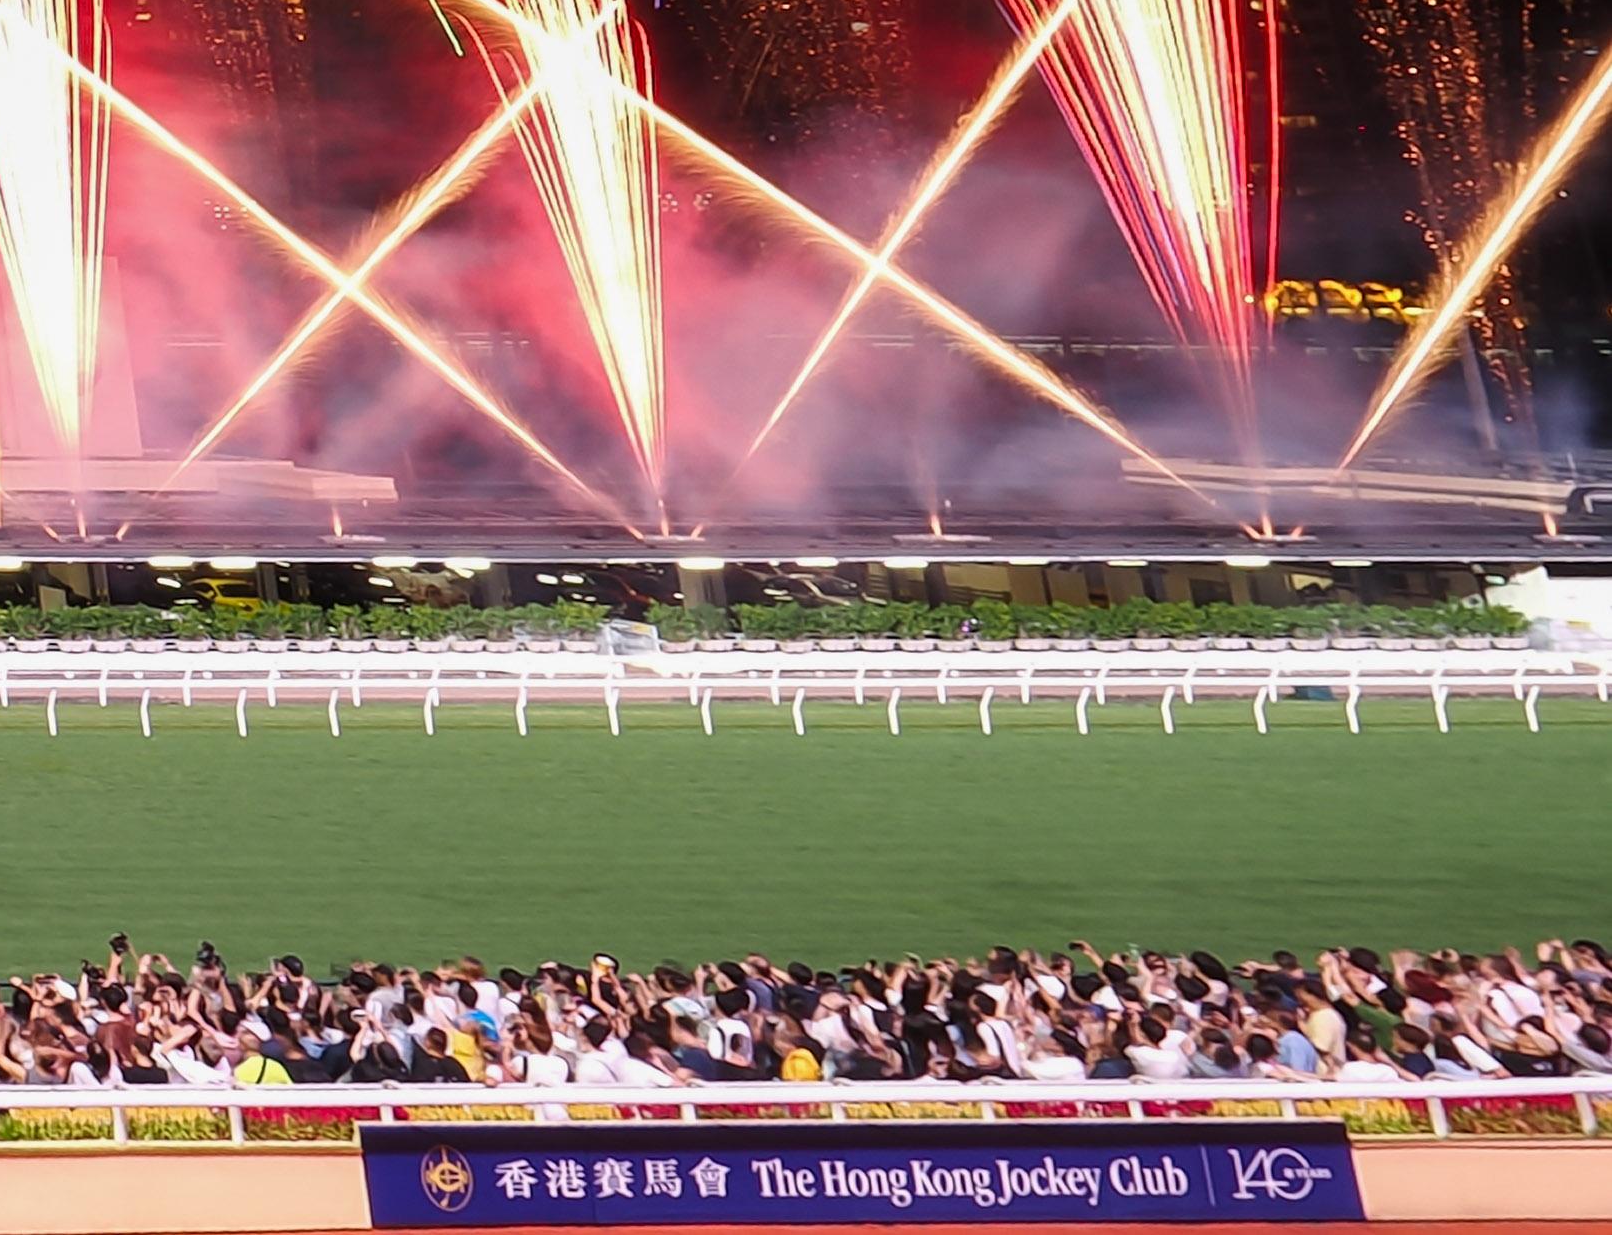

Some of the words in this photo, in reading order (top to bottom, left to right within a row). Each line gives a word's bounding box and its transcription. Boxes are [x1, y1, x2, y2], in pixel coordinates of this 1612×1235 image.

[494, 1156, 731, 1199] 香港賽馬會
[751, 1157, 816, 1197] The
[820, 1160, 913, 1207] Hong
[909, 1159, 995, 1207] Kong
[995, 1156, 1101, 1206] Jockey
[1109, 1156, 1188, 1196] Club
[1227, 1147, 1314, 1200] 140
